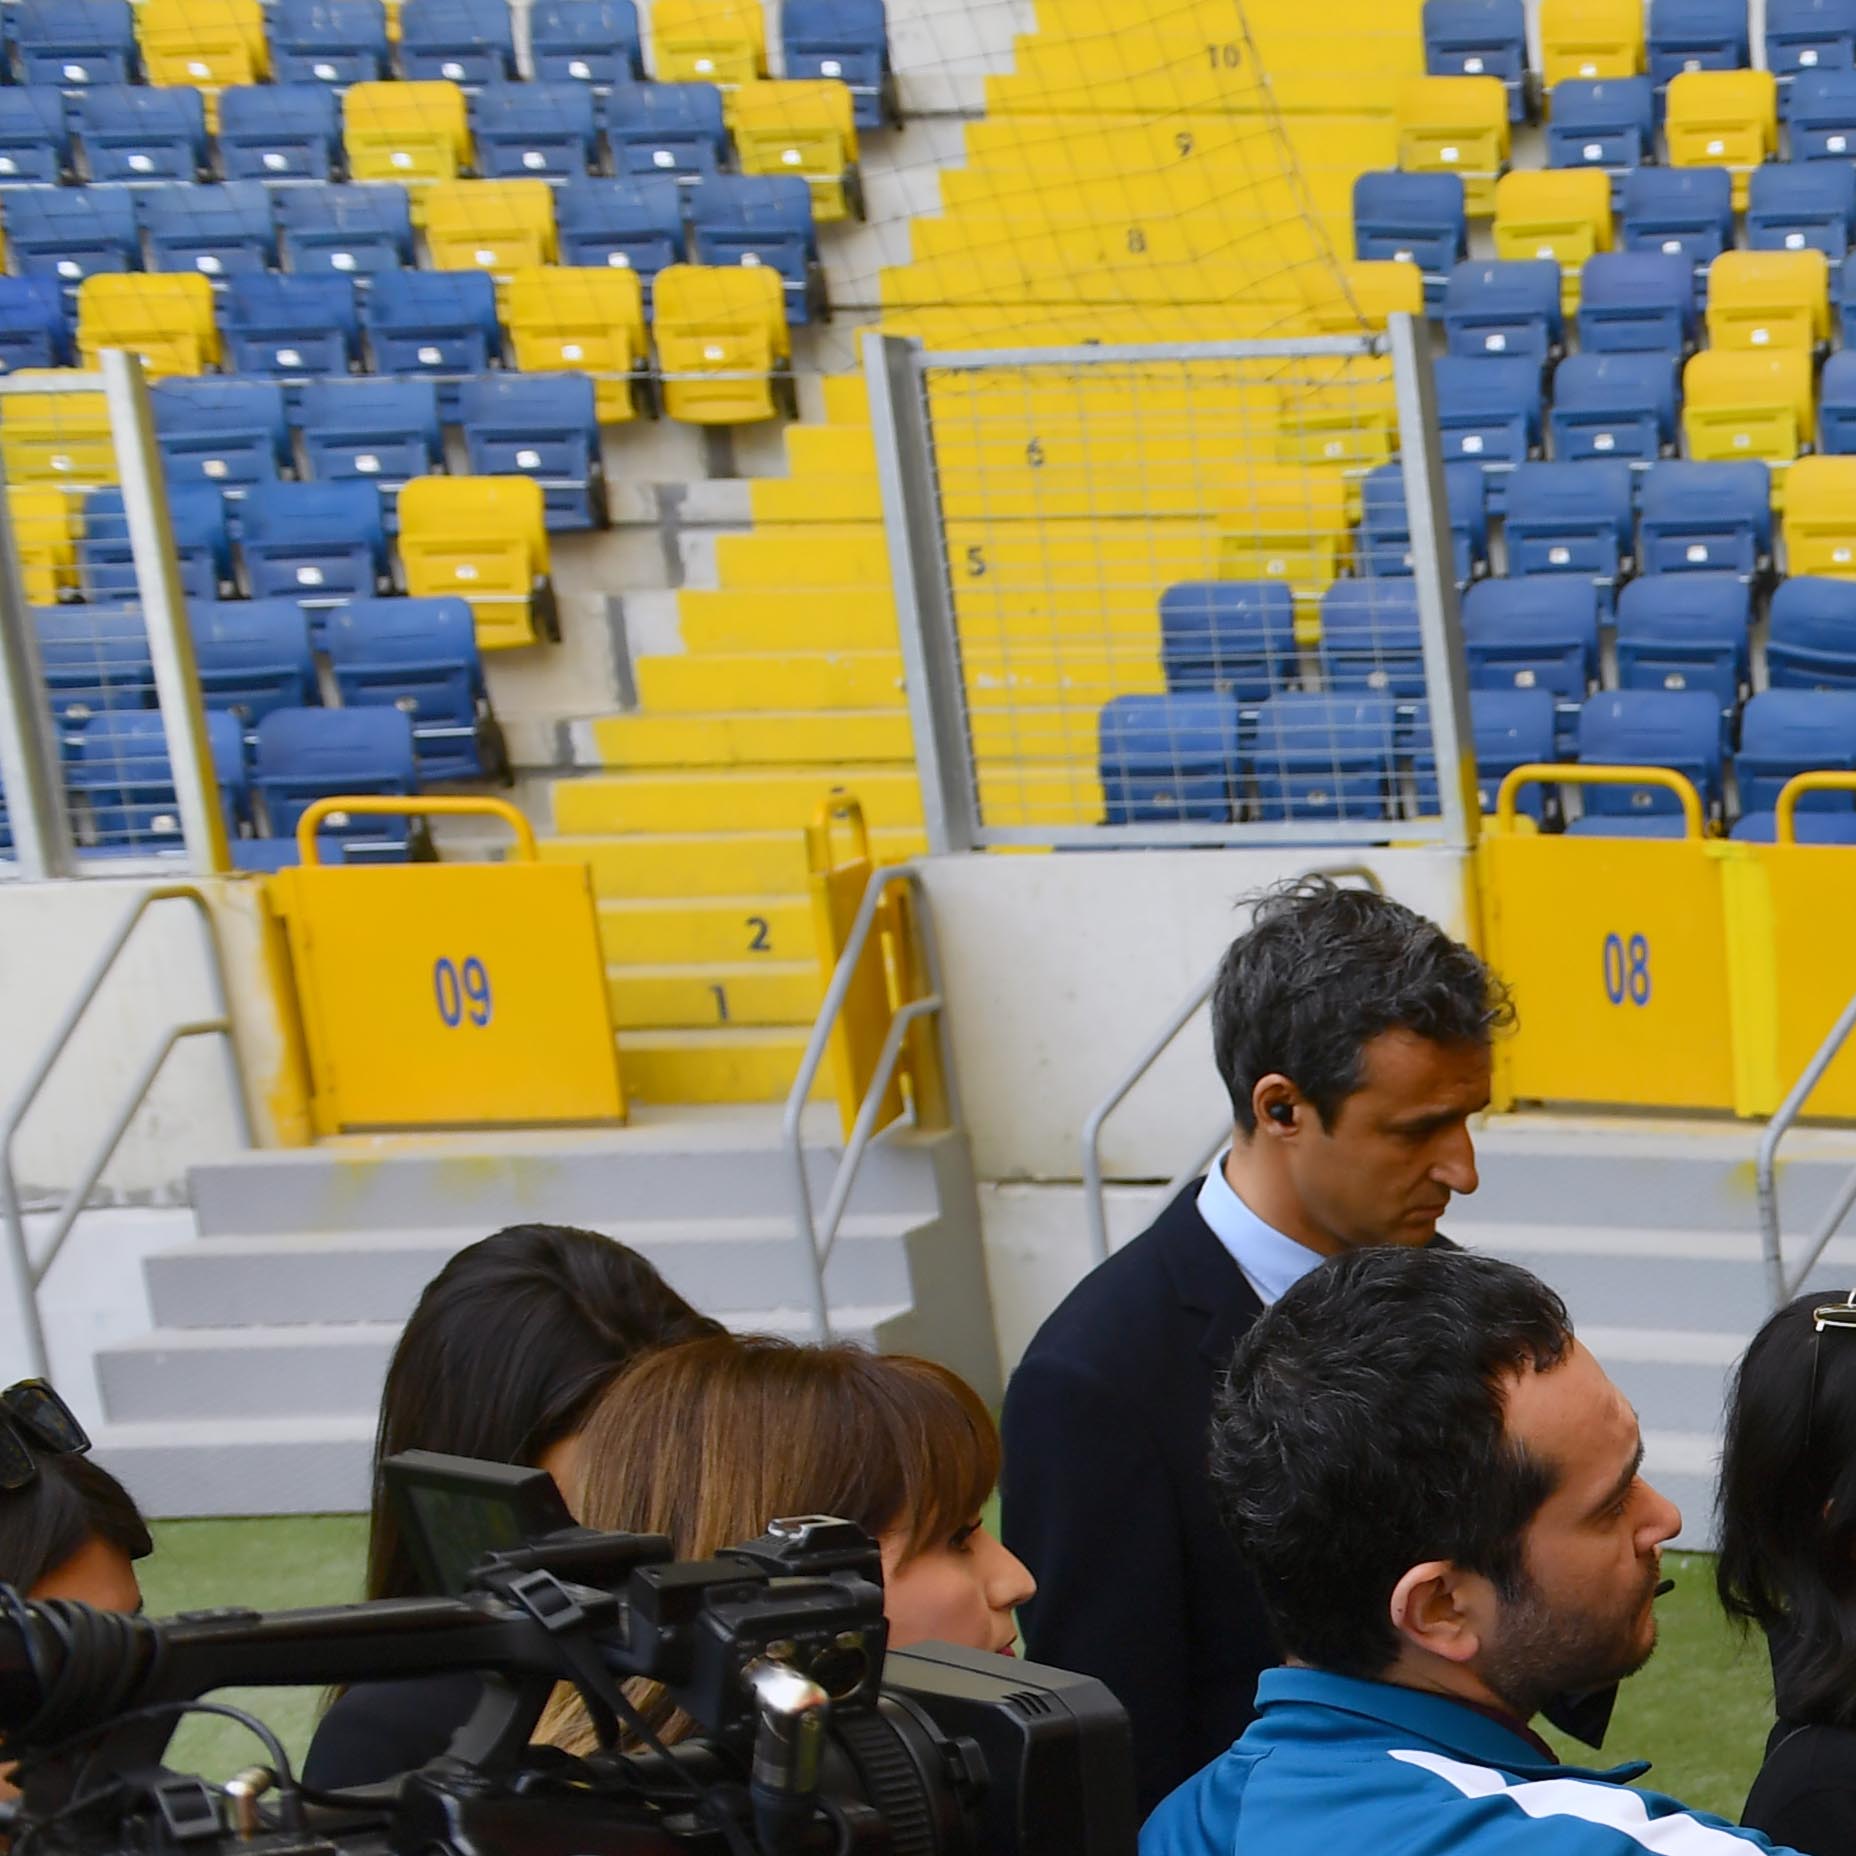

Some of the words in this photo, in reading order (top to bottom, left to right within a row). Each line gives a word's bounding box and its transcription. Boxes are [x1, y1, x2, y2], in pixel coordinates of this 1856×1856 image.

[1207, 43, 1241, 69] 10
[1175, 131, 1194, 156] 9
[1127, 227, 1146, 254] 8
[1026, 436, 1045, 468] 6
[966, 545, 986, 577] 5
[745, 916, 771, 953] 2
[1603, 931, 1652, 1007] 08
[434, 956, 492, 1028] 09
[710, 984, 729, 1022] 1
